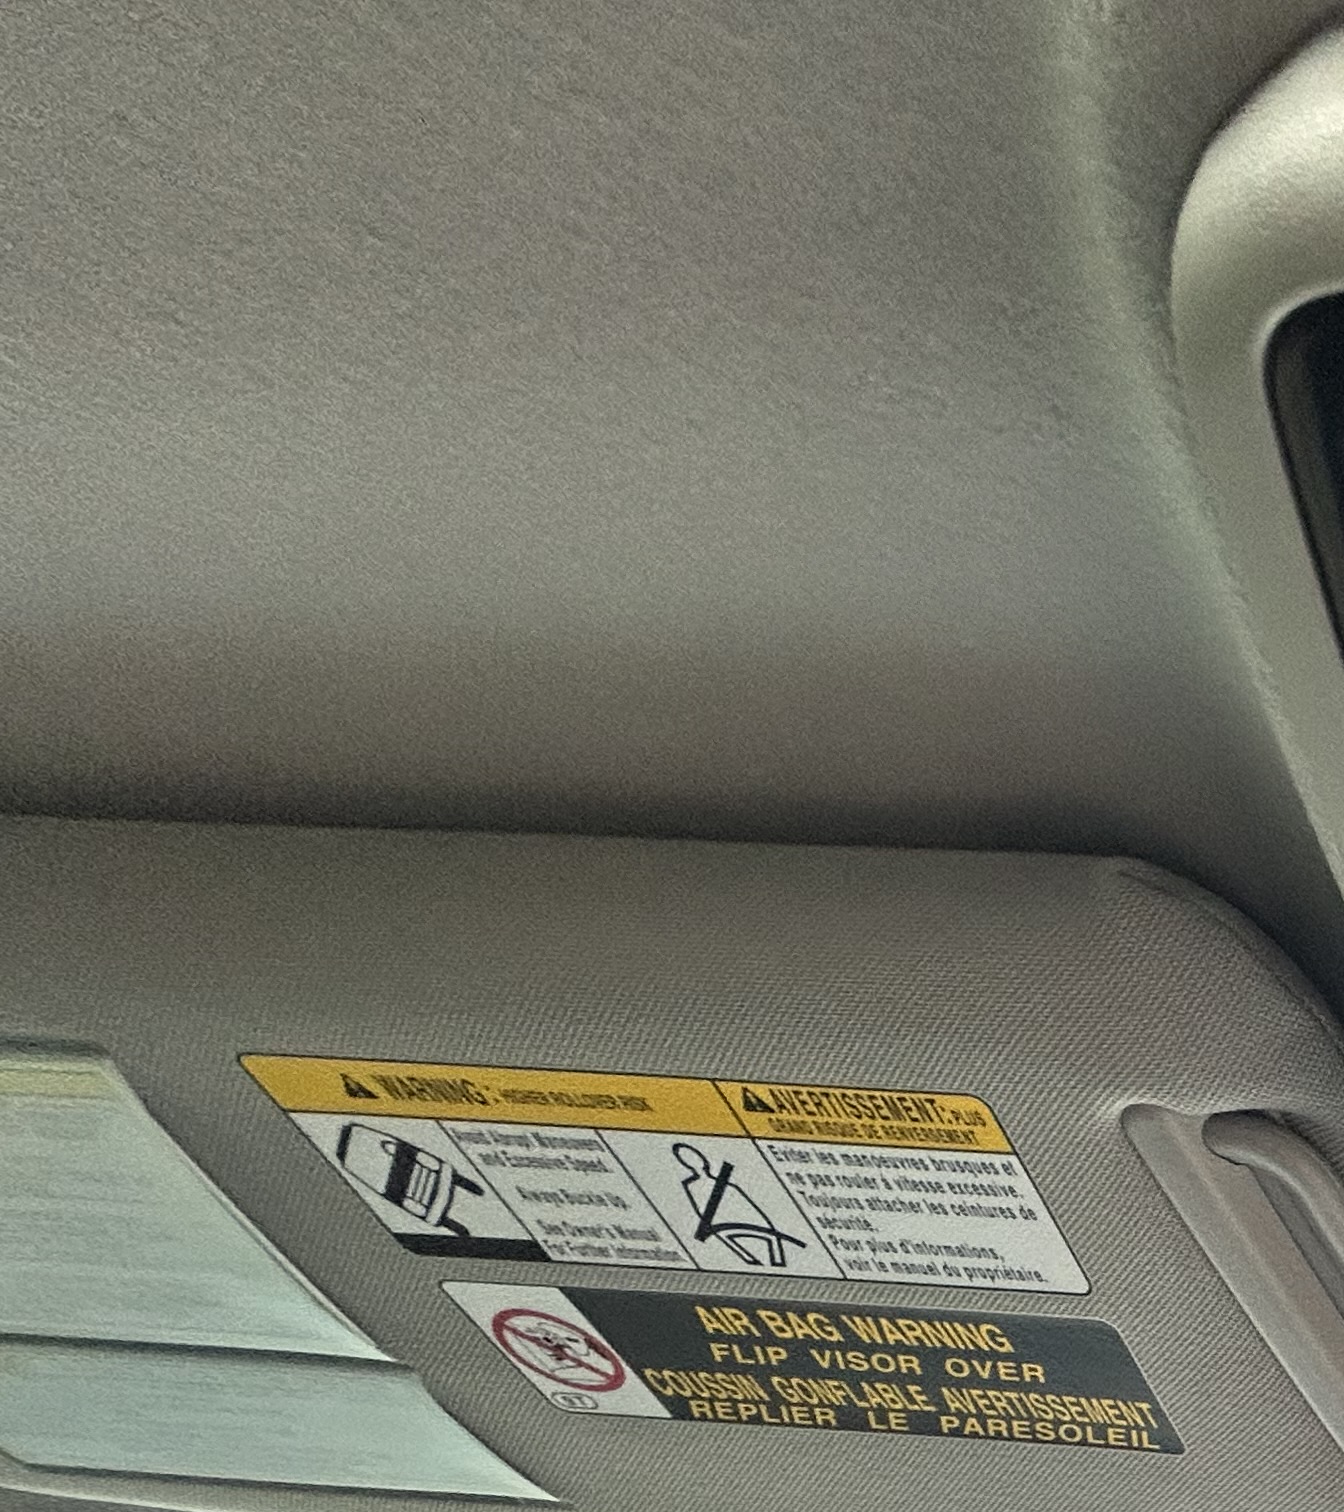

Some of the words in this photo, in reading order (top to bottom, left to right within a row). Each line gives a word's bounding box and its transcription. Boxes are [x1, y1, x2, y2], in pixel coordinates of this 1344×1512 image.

[949, 1109, 988, 1128] PLUS
[812, 1148, 840, 1166] les
[928, 1156, 1000, 1179] brusques
[1000, 1160, 1018, 1177] et
[785, 1171, 807, 1186] ne
[806, 1172, 836, 1190] pas
[834, 1173, 880, 1190] rouler
[797, 1190, 866, 1213] Toujours
[864, 1196, 924, 1214] attacher
[922, 1198, 949, 1217] les
[949, 1200, 1018, 1220] ceintures
[1018, 1204, 1038, 1221] de
[827, 1233, 864, 1252] Pour
[865, 1237, 899, 1256] plus
[843, 1259, 872, 1272] voir
[871, 1258, 890, 1274] le
[889, 1261, 942, 1277] manuel
[942, 1262, 962, 1278] du
[694, 1305, 762, 1338] AIR
[756, 1309, 844, 1342] BAG
[839, 1313, 1015, 1353] WARNING
[708, 1342, 789, 1366] FLIP
[809, 1349, 923, 1376] VISOR
[943, 1357, 1046, 1384] OVER
[643, 1366, 771, 1401] COUSSIN
[769, 1375, 937, 1412] GONFLABLE
[940, 1386, 1160, 1429] AVERTISSEMENT
[687, 1399, 838, 1427] REPLIER
[867, 1410, 910, 1431] LE
[939, 1414, 1161, 1450] PARESOLEIL
